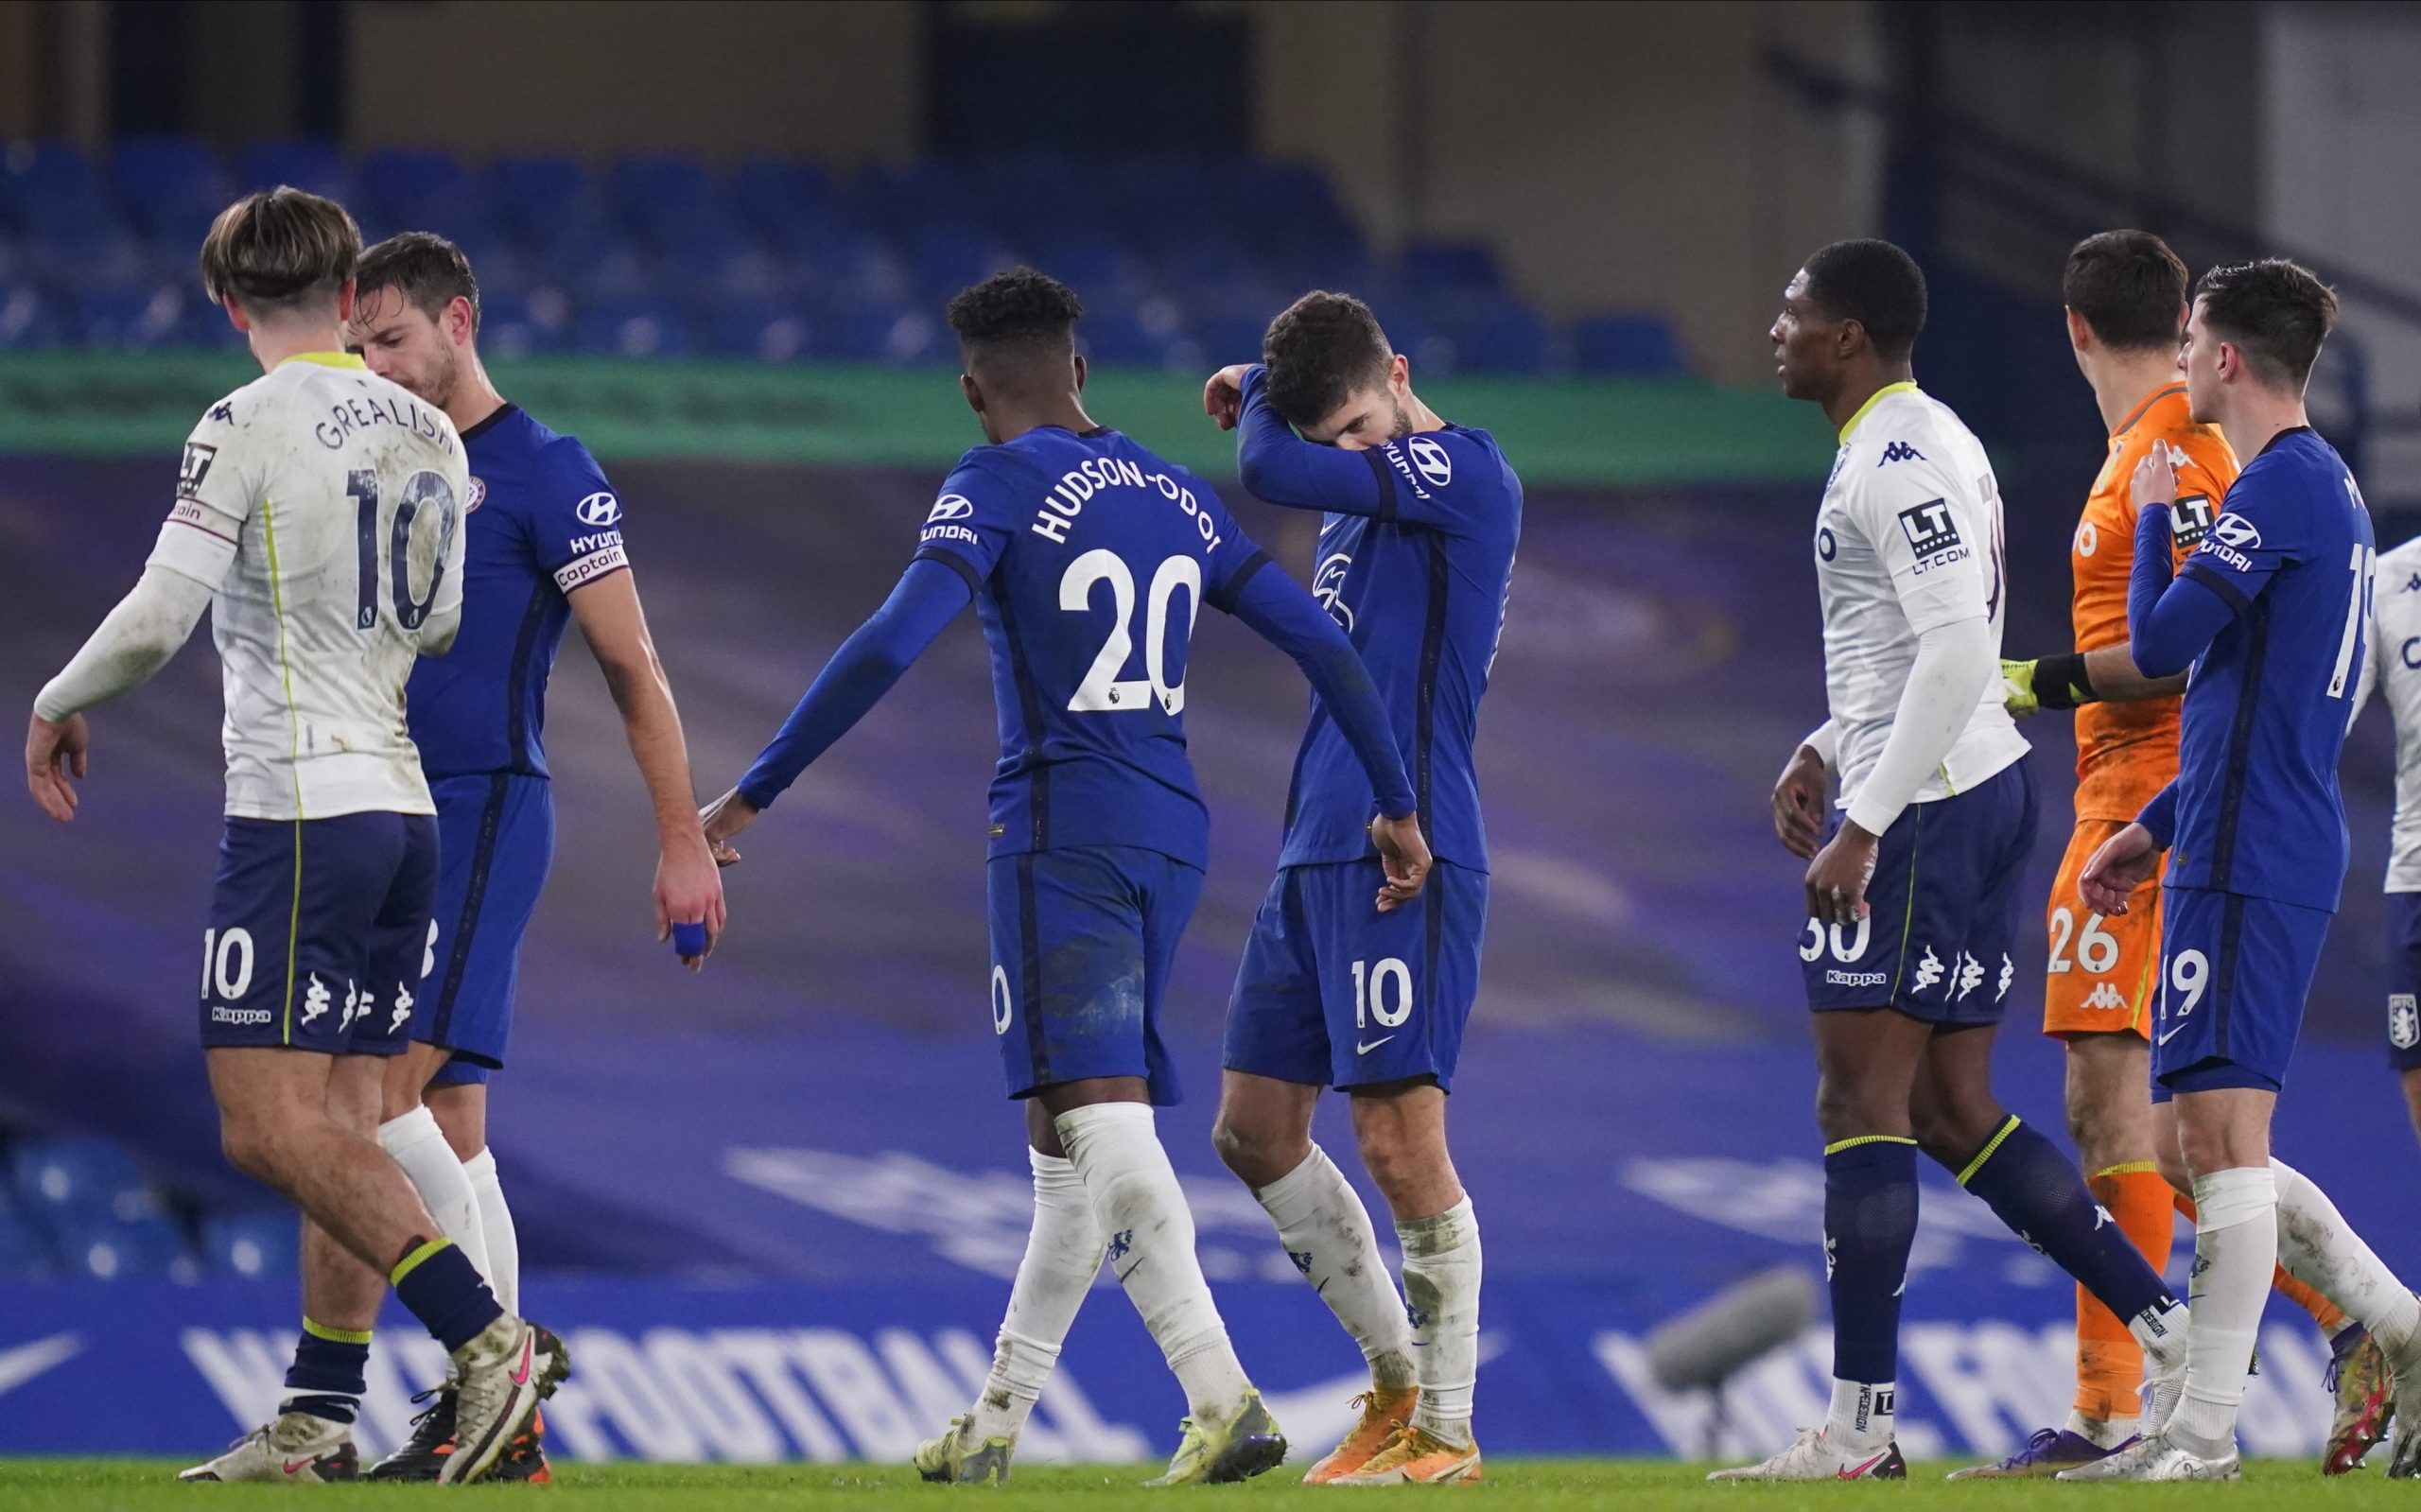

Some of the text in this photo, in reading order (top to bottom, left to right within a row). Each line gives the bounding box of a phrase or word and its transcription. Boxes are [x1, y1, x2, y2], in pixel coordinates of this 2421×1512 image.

[315, 398, 455, 455] GREALISH
[1031, 457, 1222, 554] HUDSON-ODOI
[1901, 503, 1945, 543] LT
[2170, 499, 2209, 534] LT
[345, 468, 457, 632] 10
[569, 530, 624, 554] HYUN
[920, 525, 978, 546] UNDAI
[557, 548, 622, 586] Captain
[1912, 547, 1970, 575] LT.COM
[1058, 547, 1202, 717] 20
[2047, 907, 2119, 973] 26
[200, 927, 254, 1000] 10
[1826, 970, 1887, 986] Kappa
[1350, 957, 1414, 1029] 10
[212, 1007, 271, 1025] Kappa
